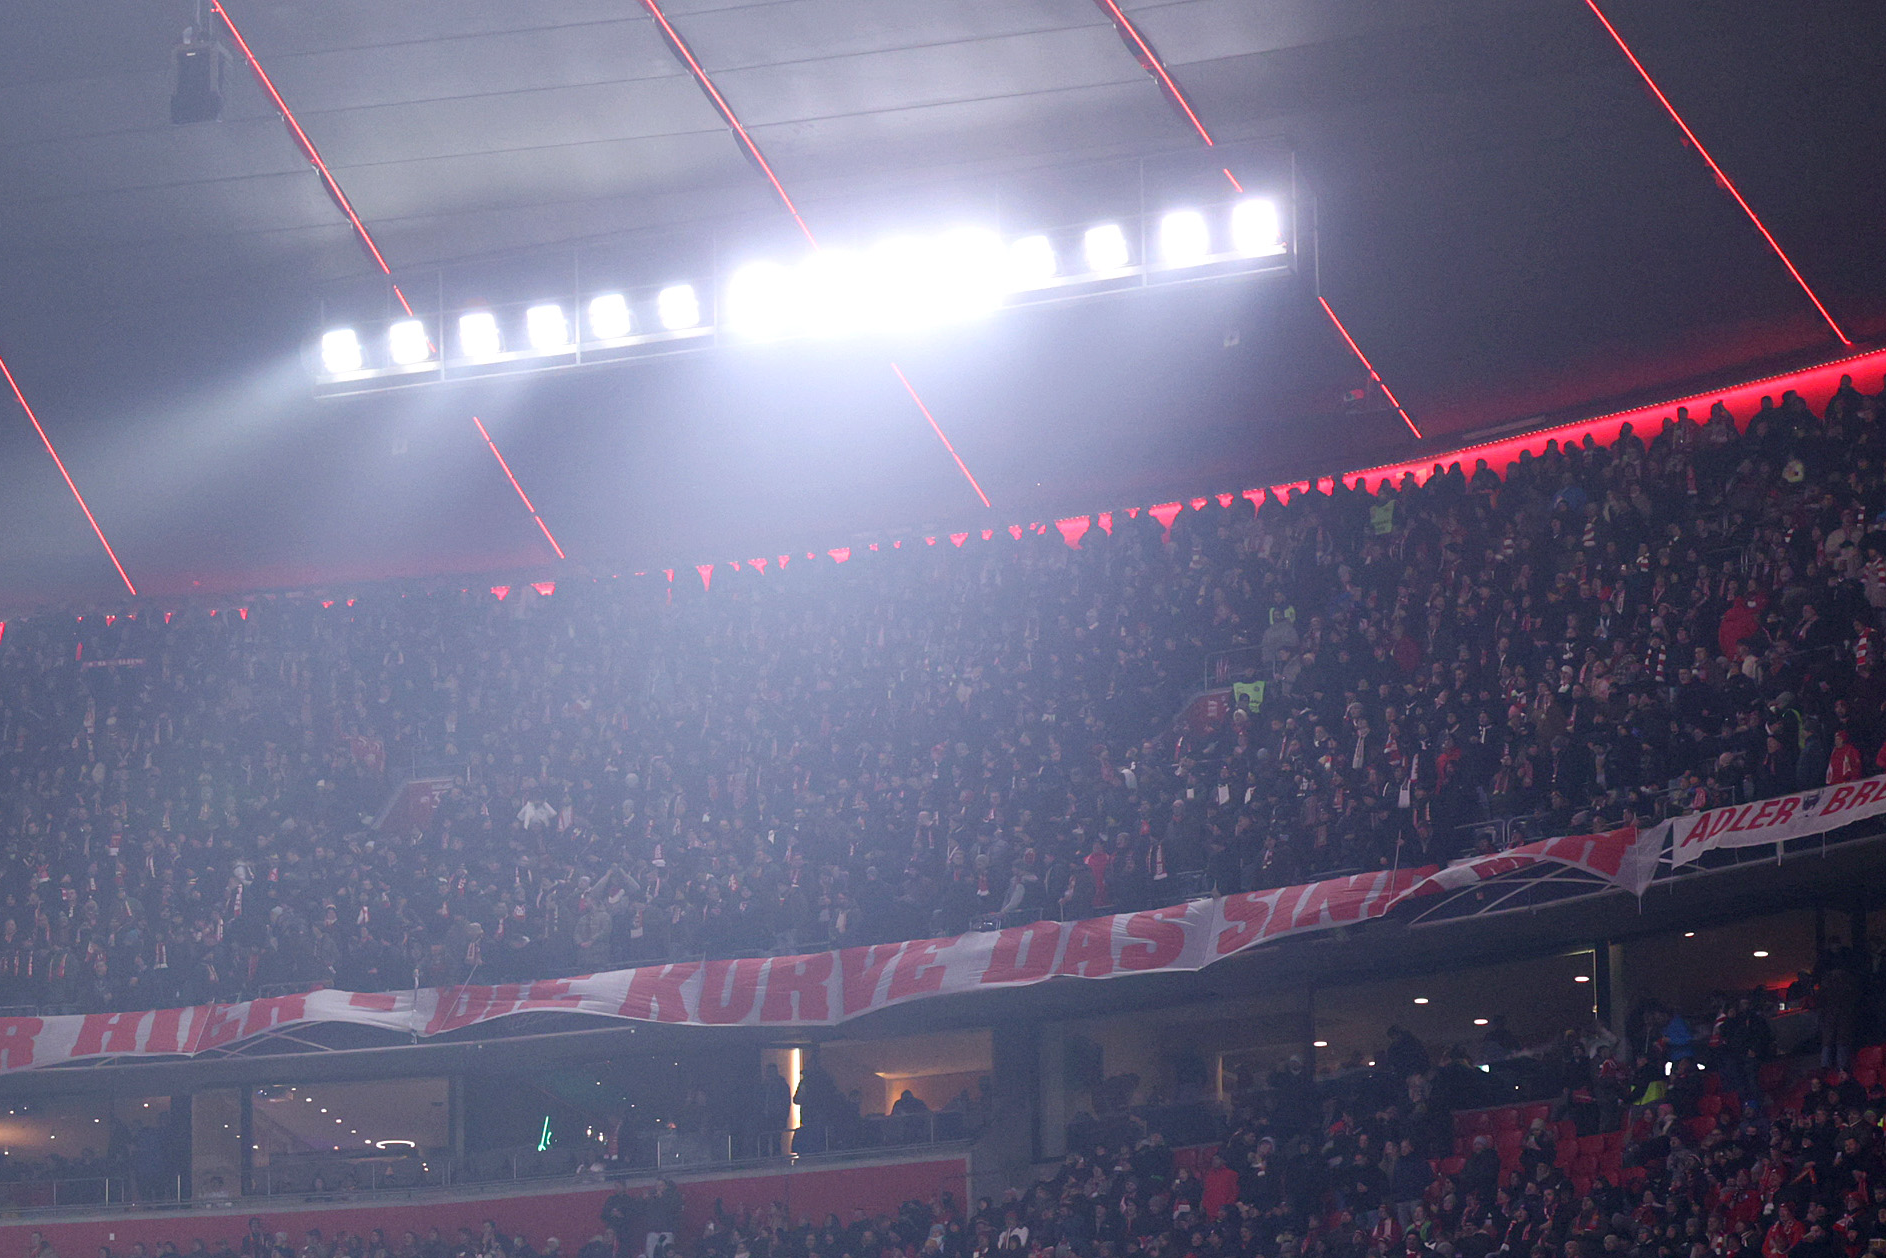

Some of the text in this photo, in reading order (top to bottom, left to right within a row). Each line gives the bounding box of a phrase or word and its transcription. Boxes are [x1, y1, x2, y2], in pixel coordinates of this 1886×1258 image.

[1680, 797, 1801, 848] ADLER
[600, 937, 956, 1024] KURVE
[981, 902, 1193, 984] DAS
